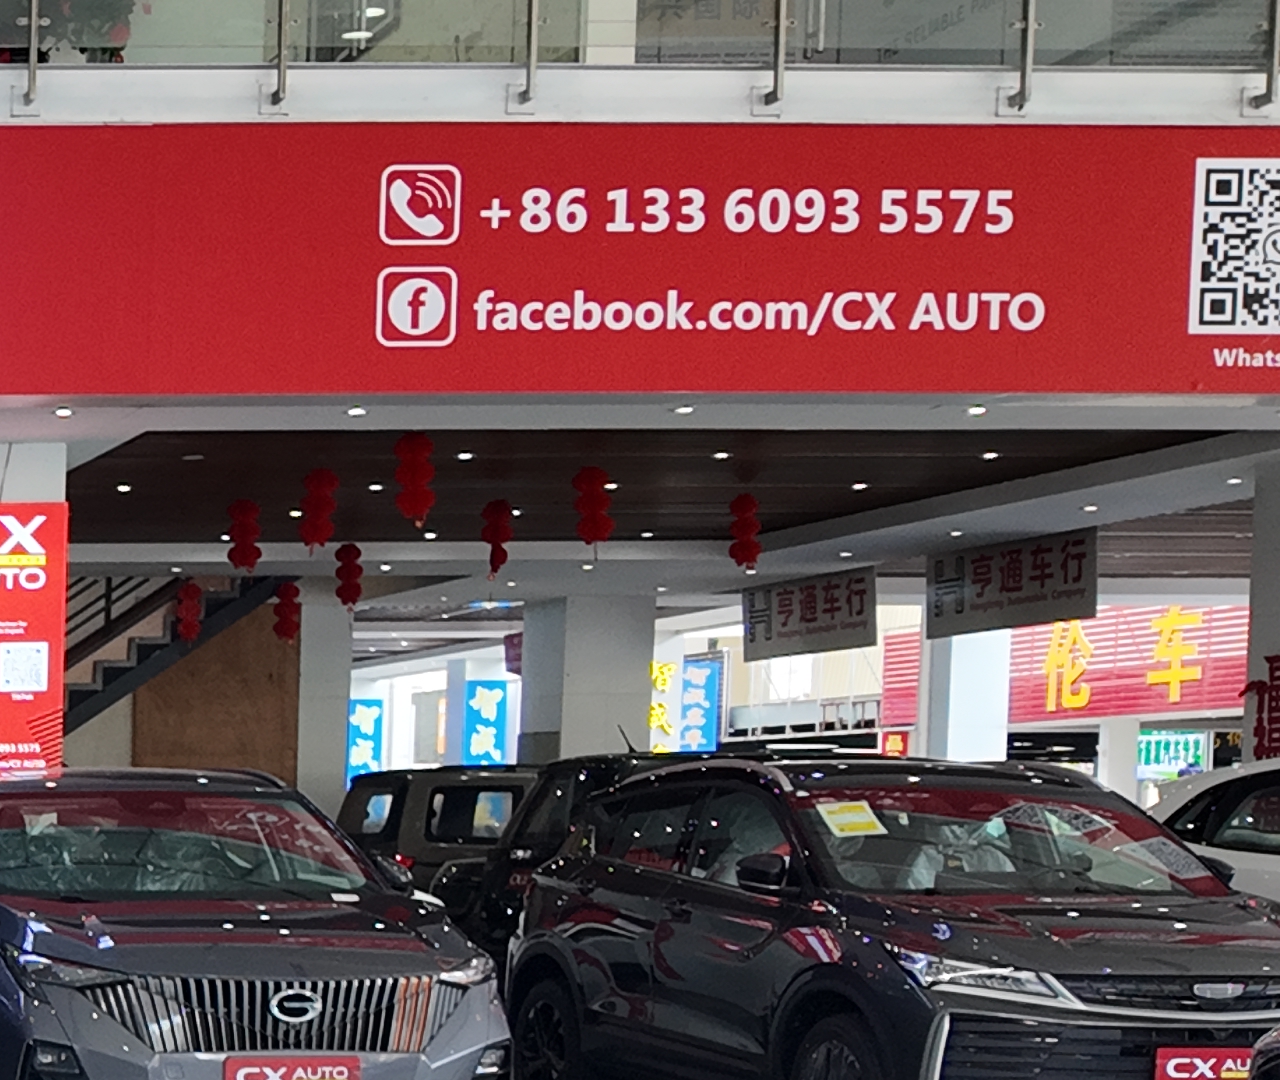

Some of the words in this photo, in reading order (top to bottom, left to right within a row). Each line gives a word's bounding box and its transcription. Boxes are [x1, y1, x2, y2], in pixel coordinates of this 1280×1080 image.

[479, 188, 588, 233] +86
[605, 188, 706, 233] 133
[723, 188, 860, 234] 6093
[879, 189, 1014, 234] 5575
[472, 289, 897, 337] facebook.com/CX
[908, 292, 1046, 332] AUTO
[292, 1066, 349, 1080] AUTO
[1166, 1057, 1217, 1079] CX
[1222, 1058, 1251, 1071] AU
